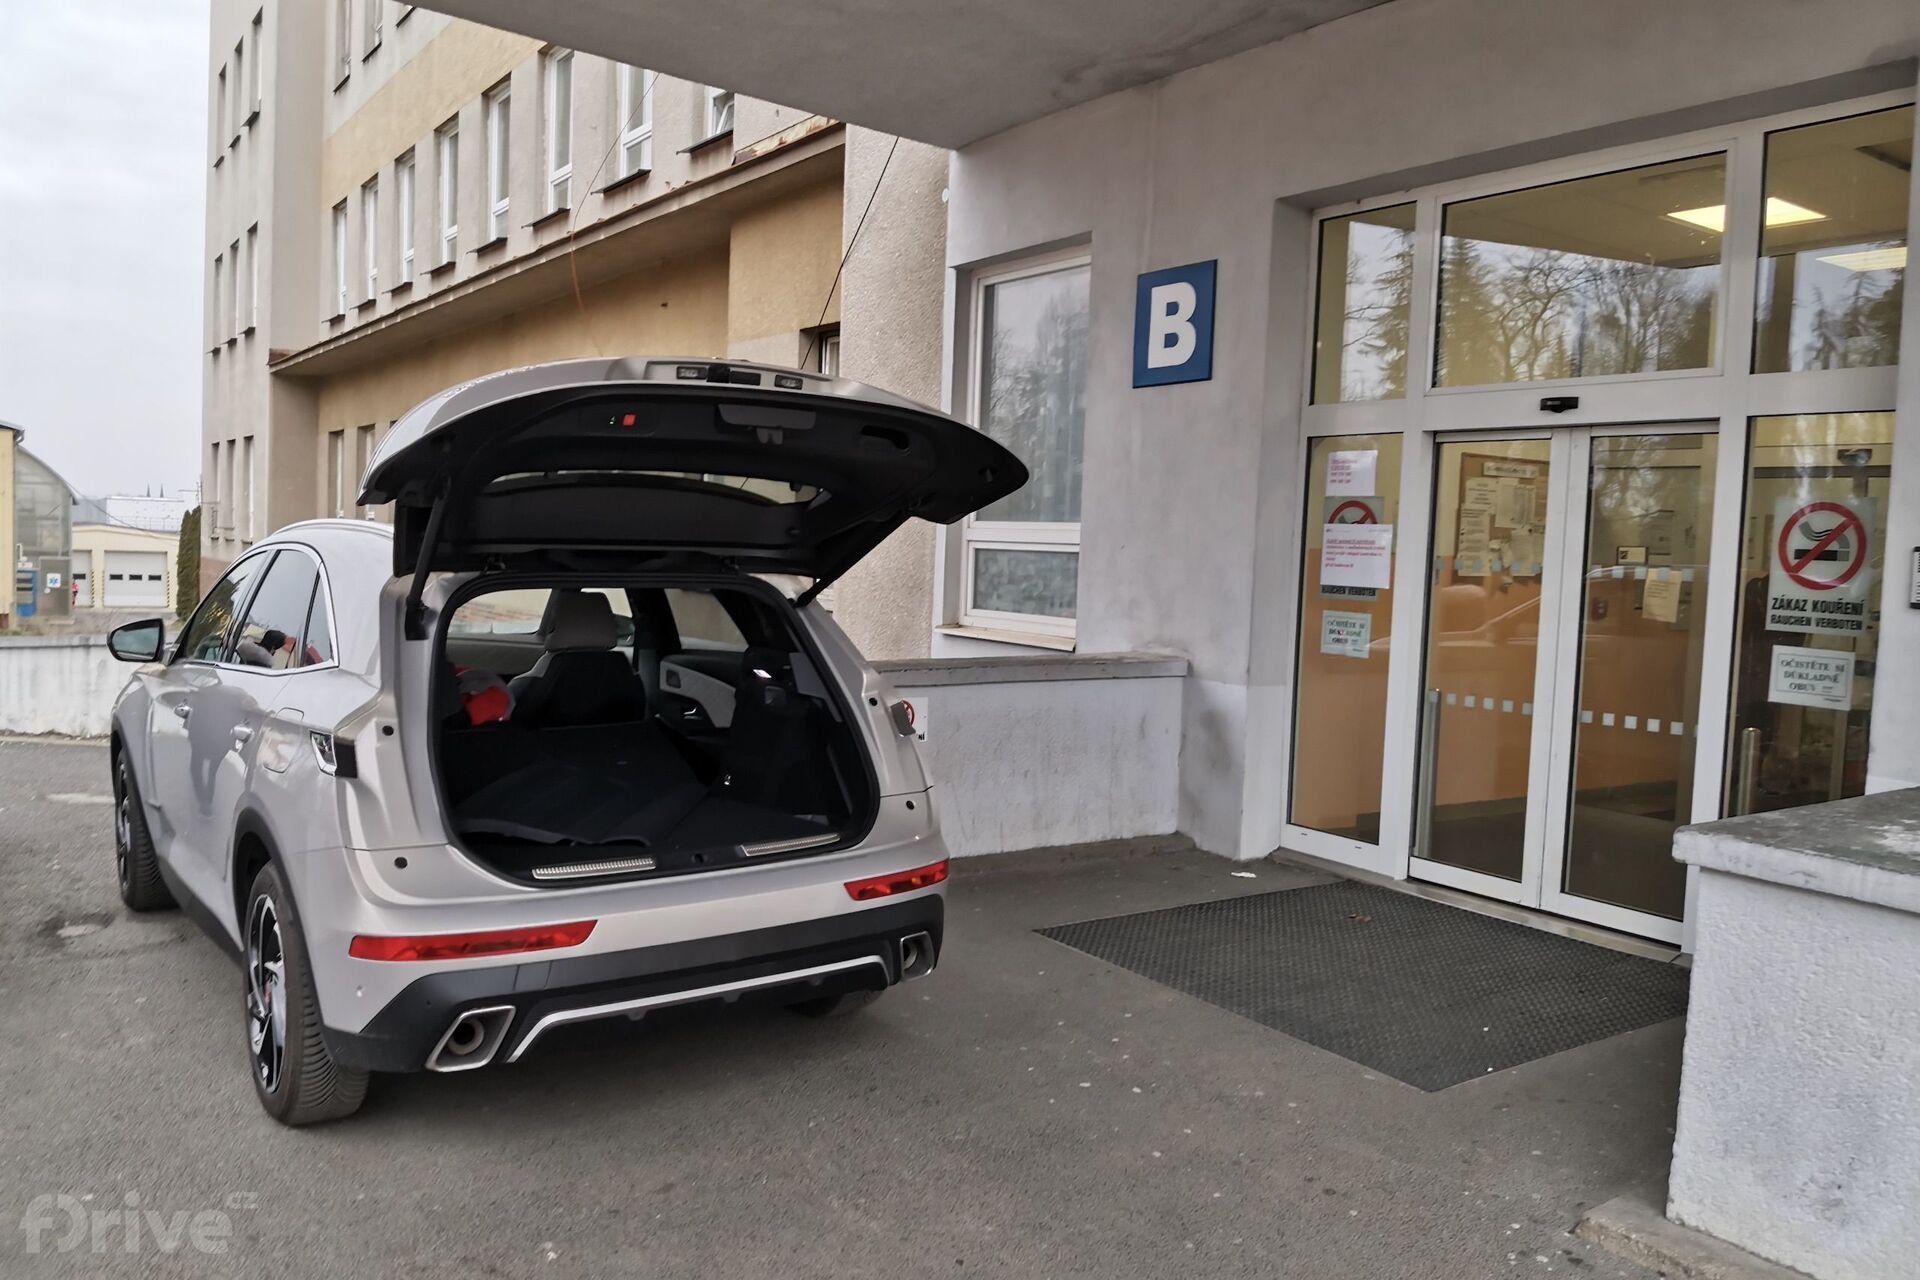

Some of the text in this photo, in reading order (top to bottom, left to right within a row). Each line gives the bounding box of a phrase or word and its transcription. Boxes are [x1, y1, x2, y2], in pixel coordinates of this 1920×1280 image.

[1147, 282, 1197, 369] B
[1771, 595, 1864, 615] ZÁKAZ KOUŘENÍ
[1770, 614, 1862, 630] RAUCHEN VERBOTEN
